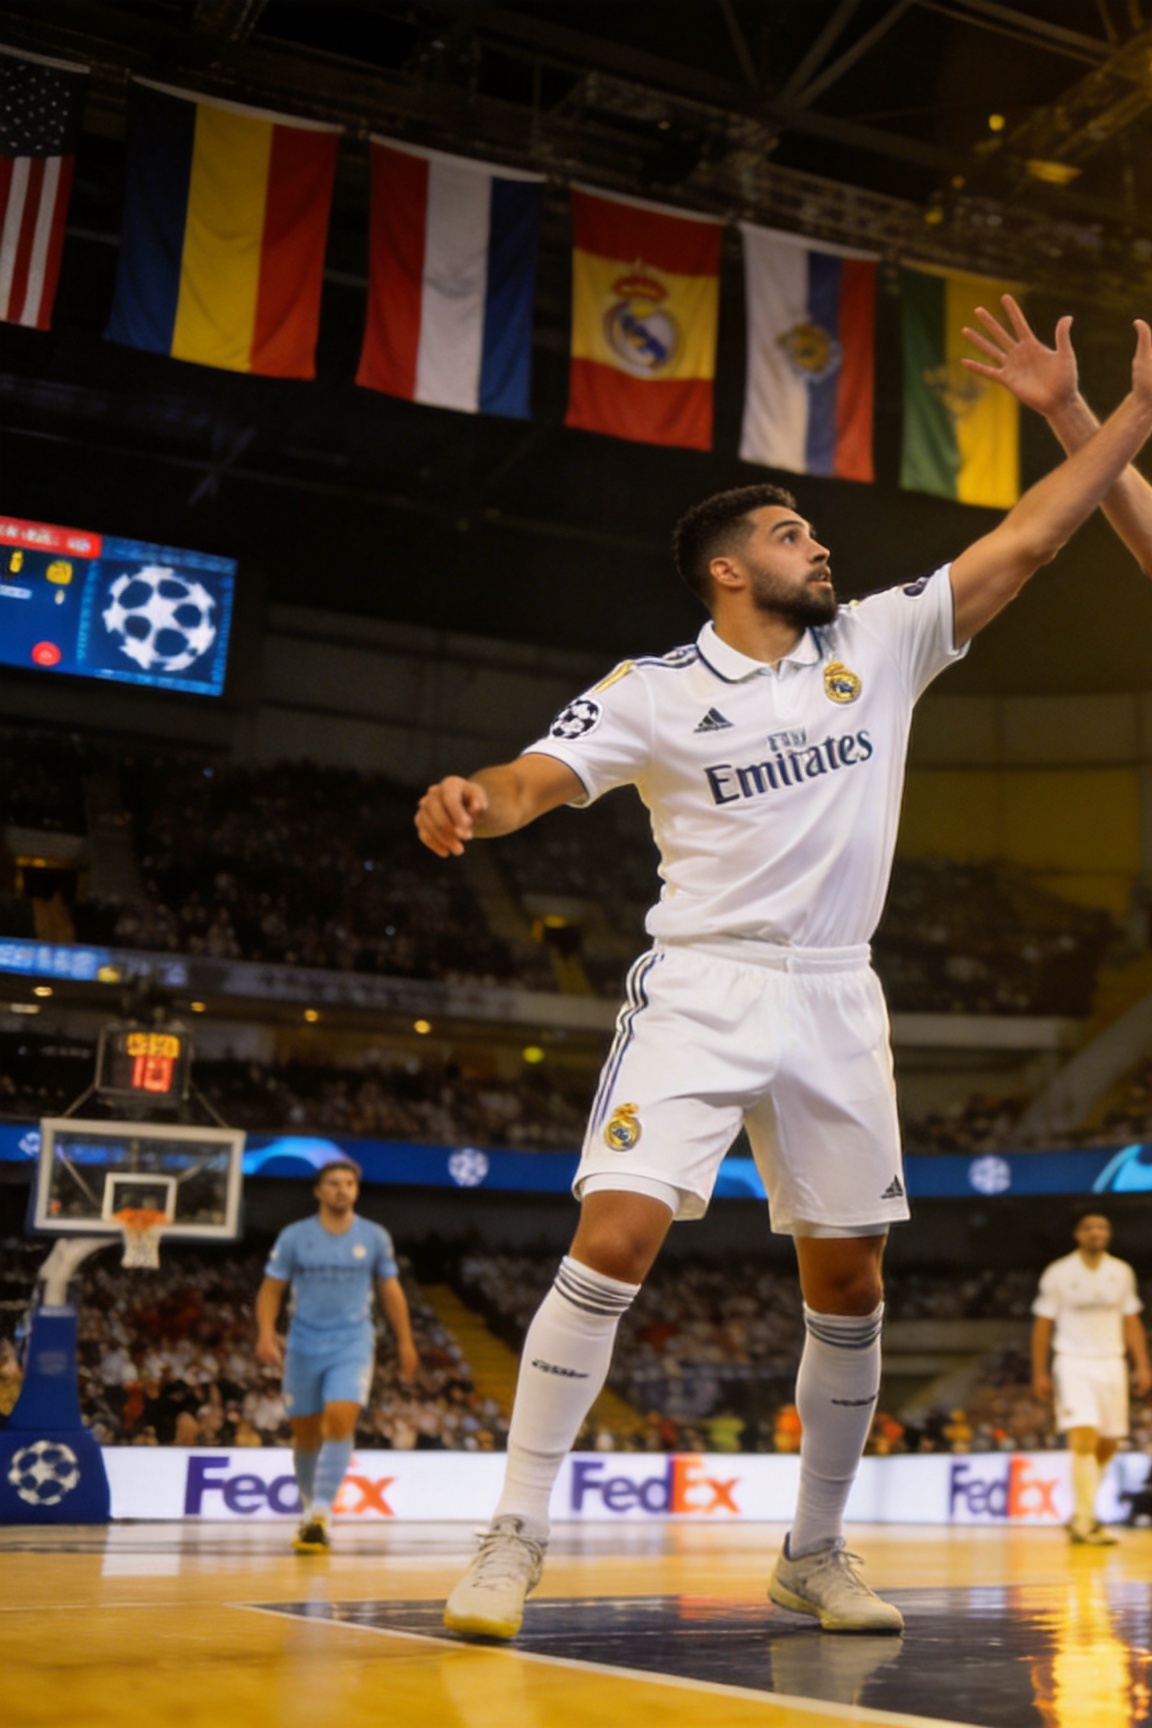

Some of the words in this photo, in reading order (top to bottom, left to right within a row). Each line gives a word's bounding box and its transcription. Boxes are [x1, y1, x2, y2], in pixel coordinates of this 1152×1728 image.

[704, 730, 873, 805] Emirates
[572, 1453, 741, 1514] FedEx
[948, 1453, 1061, 1518] FedEx
